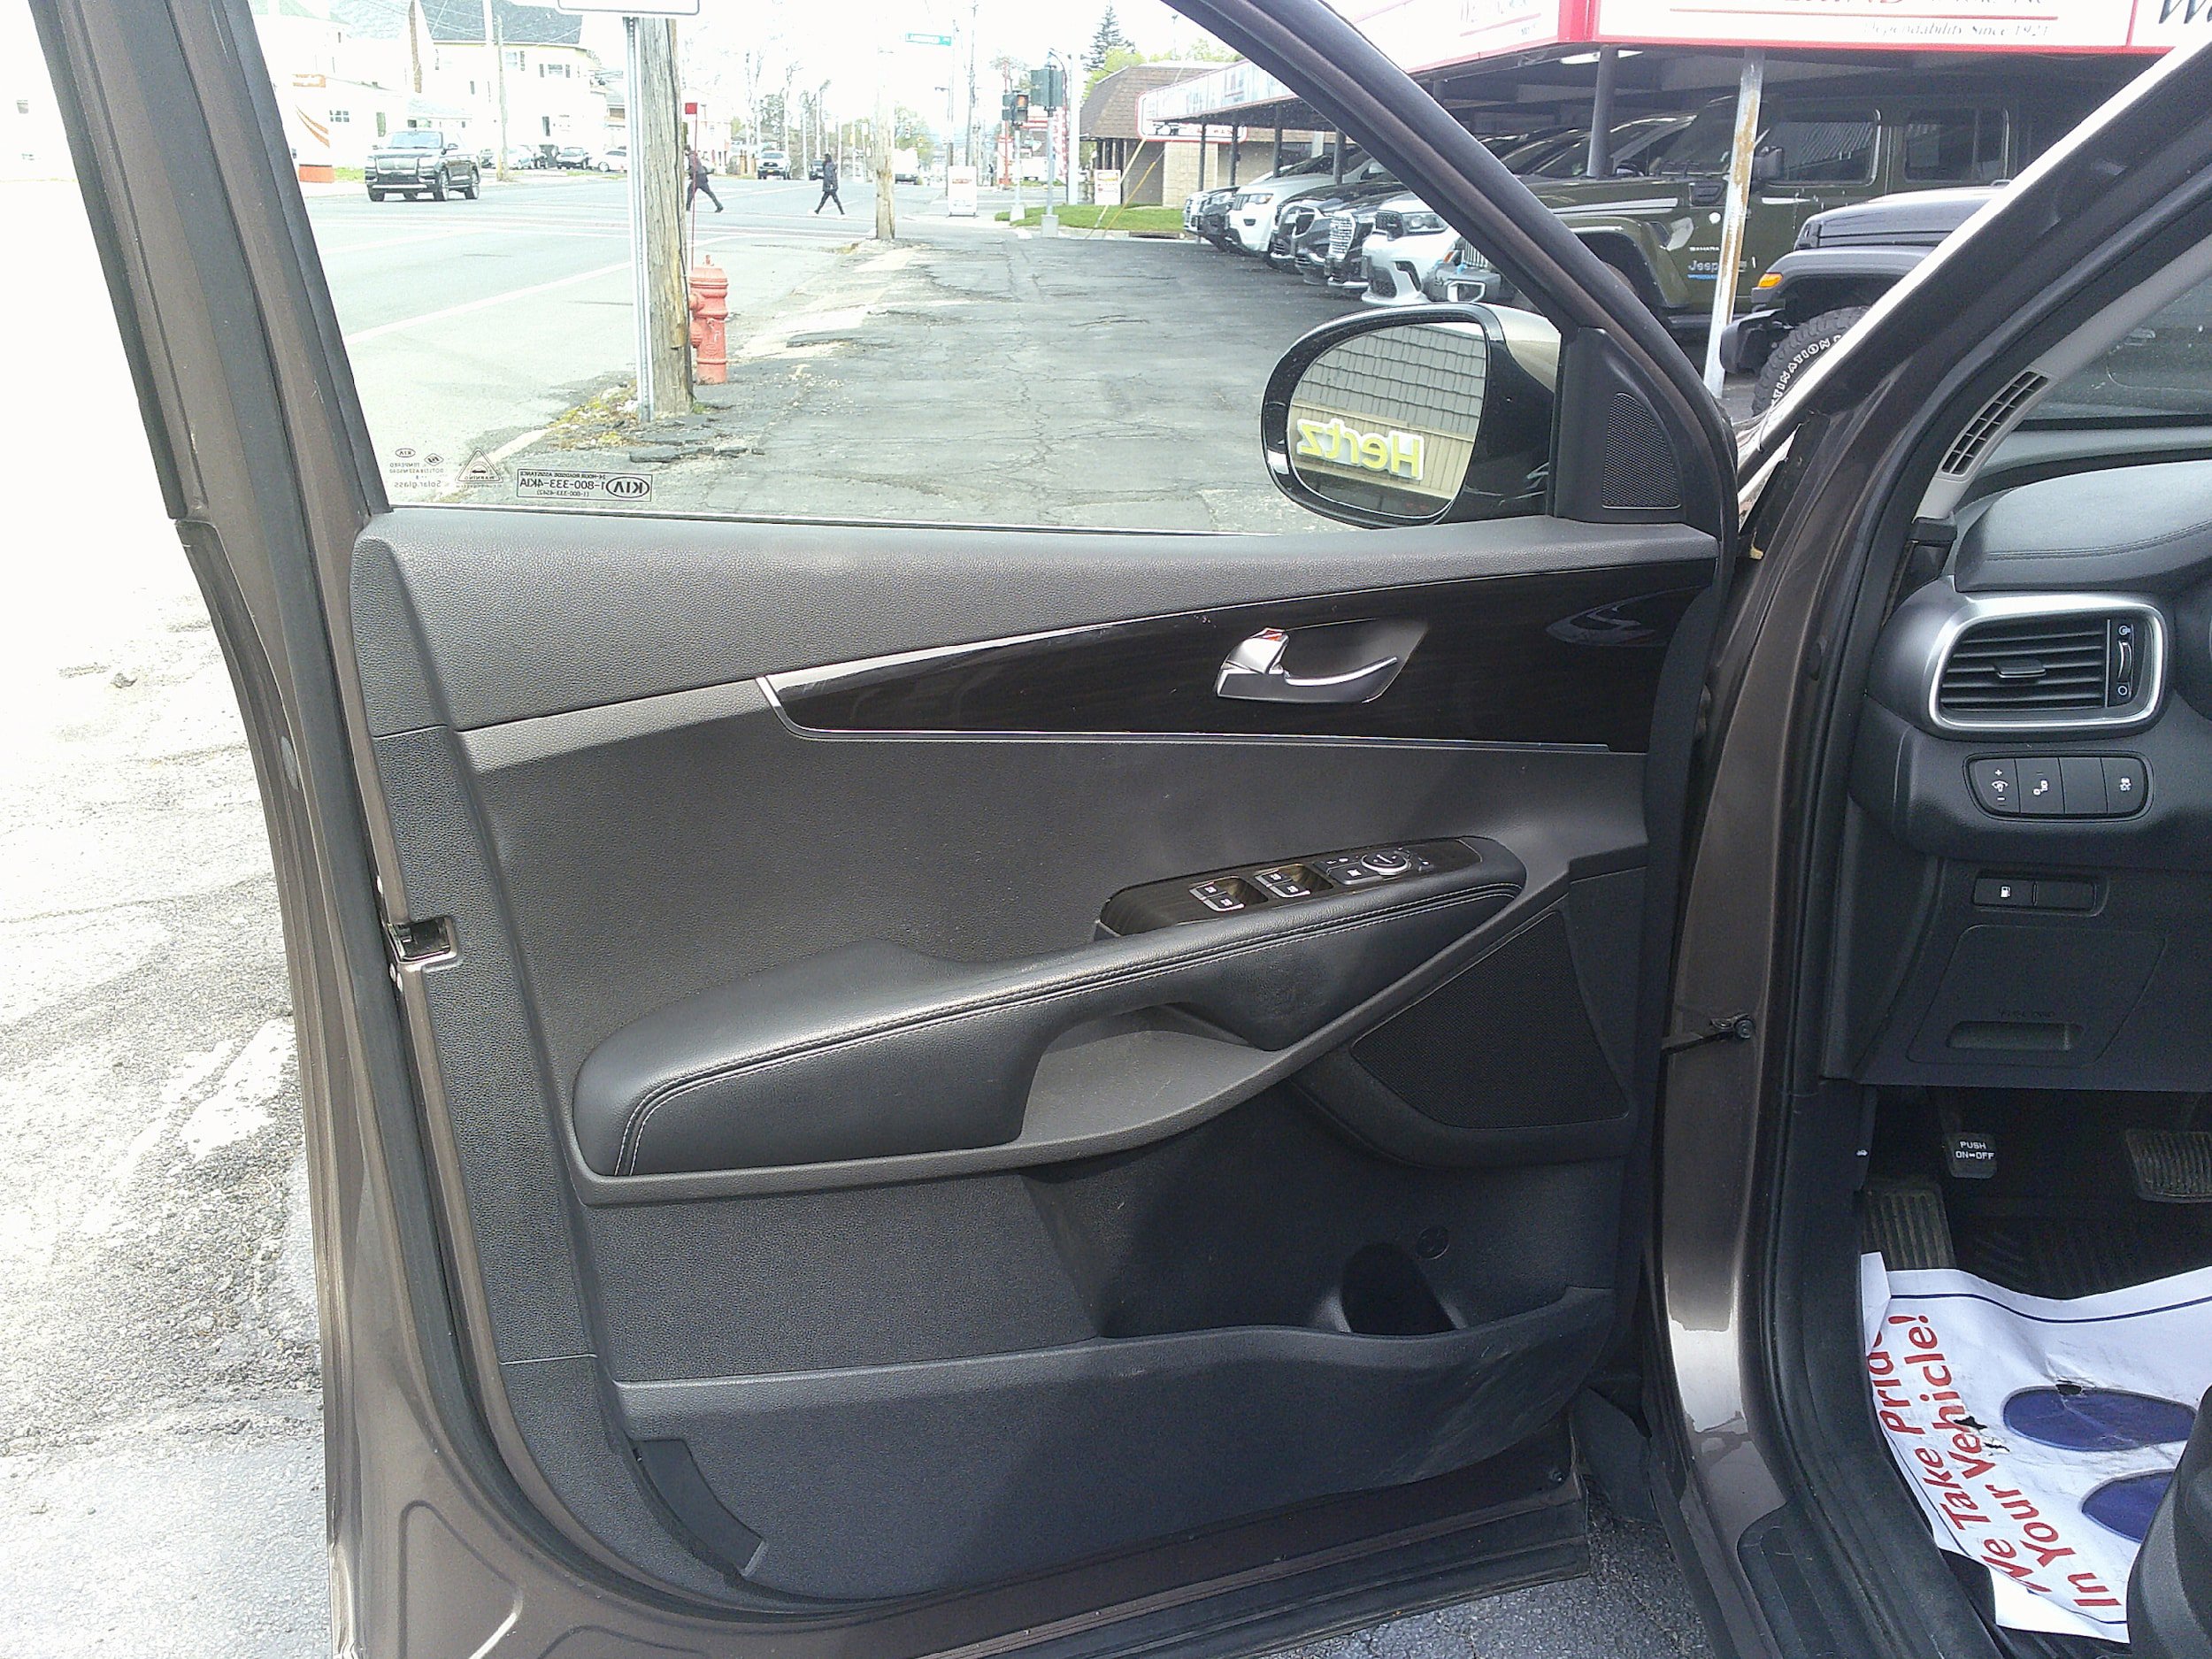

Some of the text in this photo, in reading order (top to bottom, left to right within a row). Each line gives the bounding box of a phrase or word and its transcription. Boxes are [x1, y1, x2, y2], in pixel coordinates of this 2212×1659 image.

[1688, 260, 1718, 273] Jeep
[1960, 1141, 1986, 1149] PUSH
[1888, 1315, 2122, 1606] In Your Vehicle!
[1915, 1448, 1991, 1530] Take
